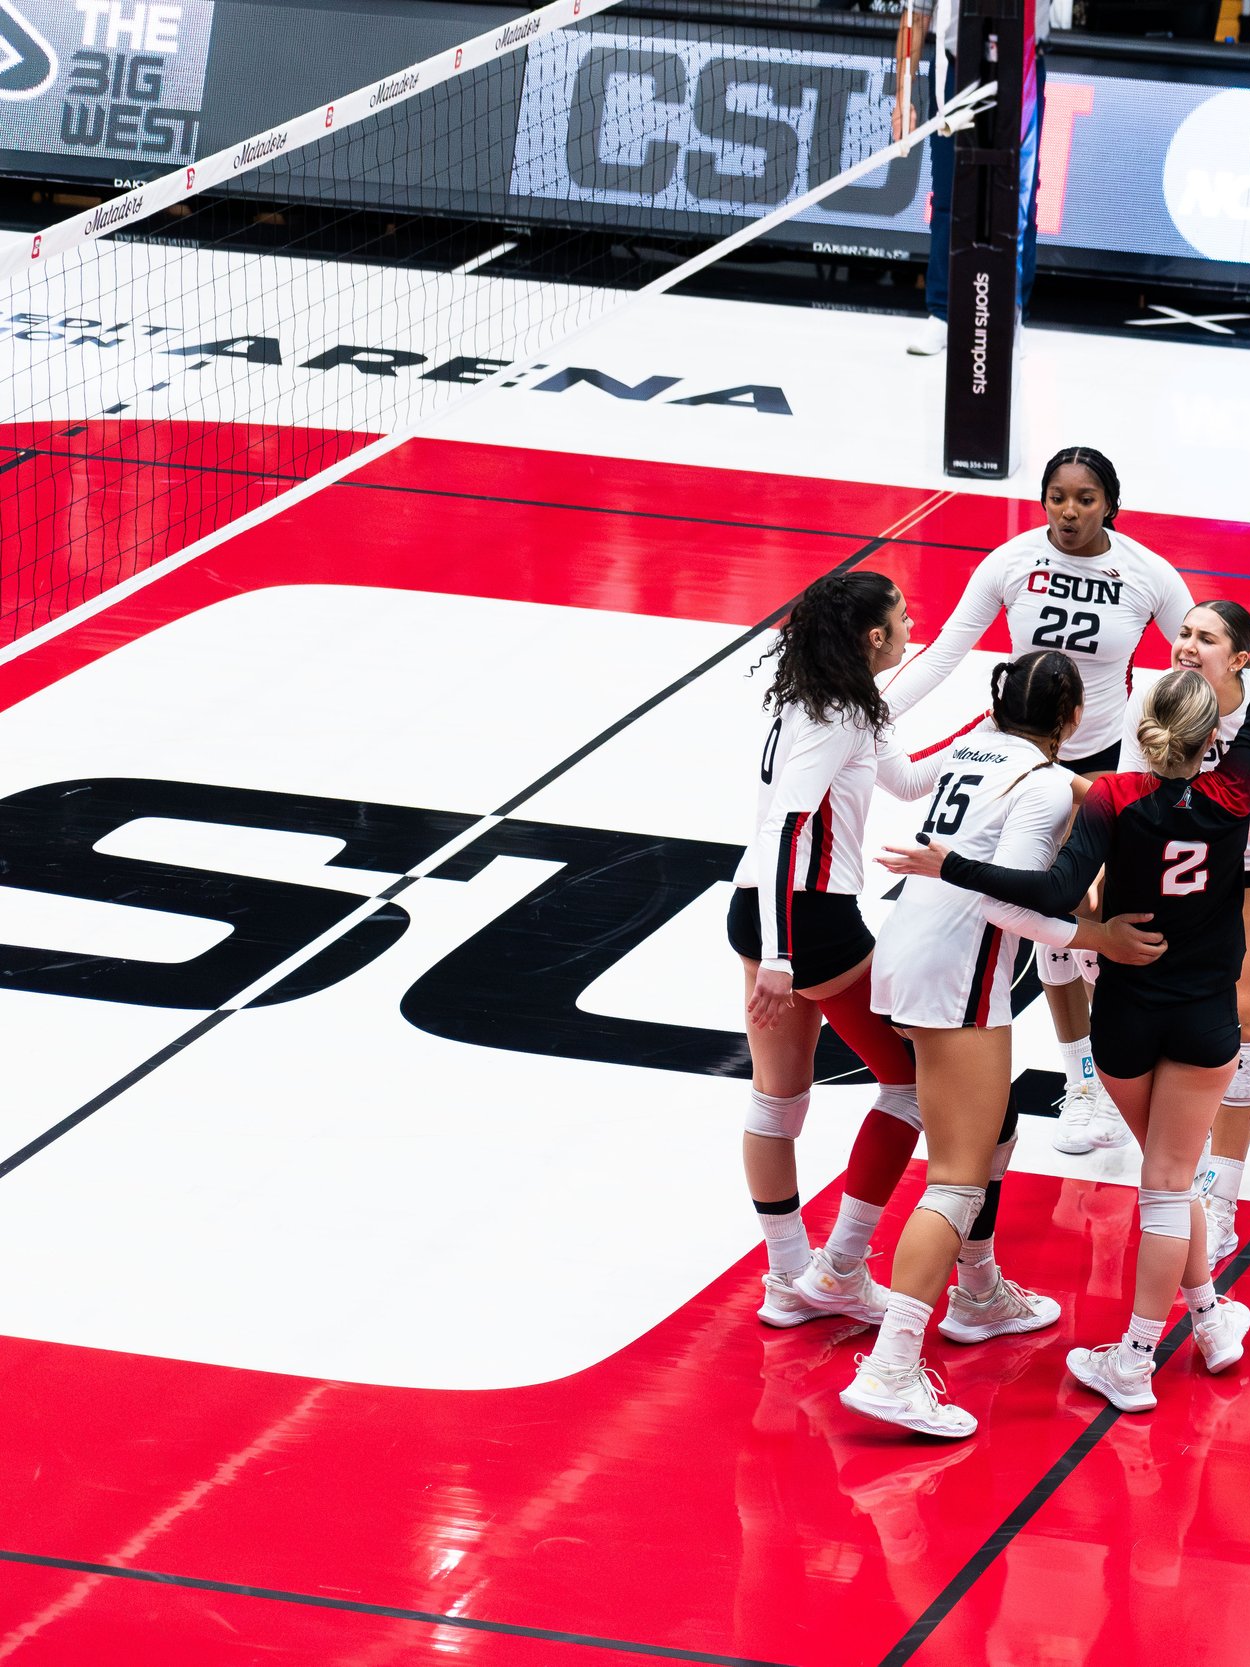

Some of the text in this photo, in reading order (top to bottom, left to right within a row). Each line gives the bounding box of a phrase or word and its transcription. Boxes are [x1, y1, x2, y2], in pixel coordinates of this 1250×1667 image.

[76, 0, 183, 52] THE
[495, 16, 541, 50] Matadors
[369, 70, 419, 108] Matadors
[60, 101, 202, 156] WEST
[233, 131, 287, 169] Matadors
[566, 47, 1095, 235] CSU
[84, 195, 143, 235] Matadors
[0, 311, 183, 336] EDIT
[970, 272, 990, 394] sports imports
[157, 334, 794, 416] ARENA
[1027, 571, 1124, 605] CSUN
[1032, 606, 1100, 655] 22
[761, 717, 782, 785] 0
[922, 772, 984, 836] 15
[1161, 840, 1209, 896] 2
